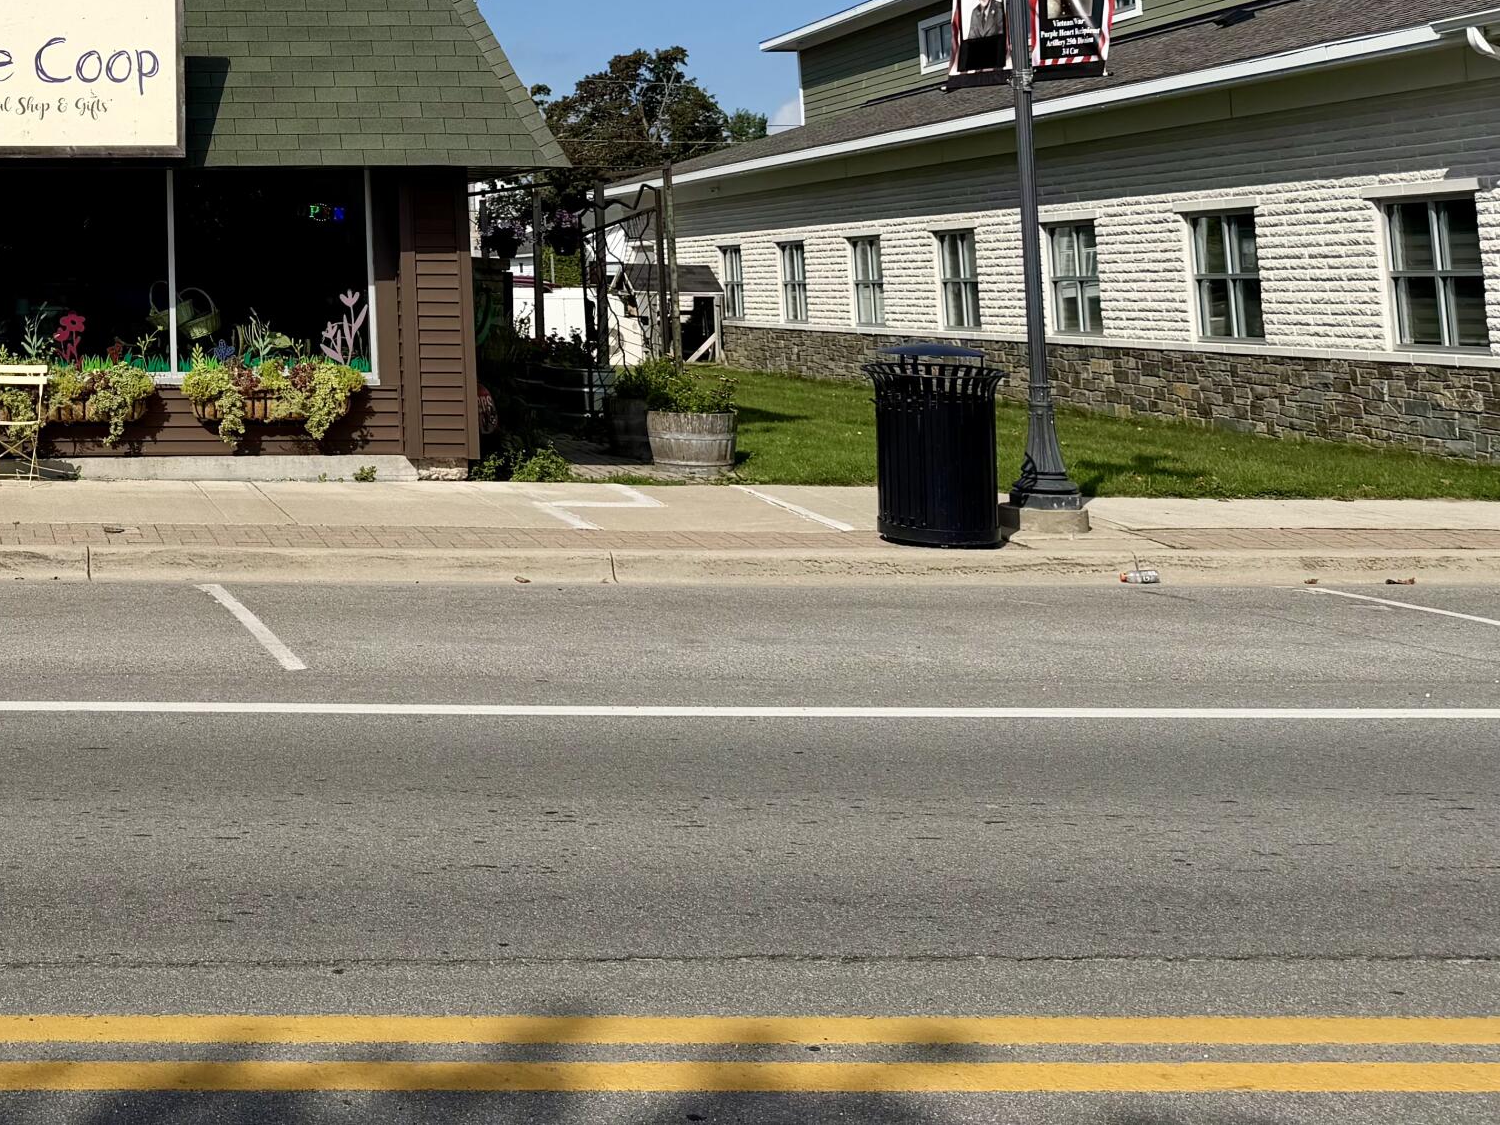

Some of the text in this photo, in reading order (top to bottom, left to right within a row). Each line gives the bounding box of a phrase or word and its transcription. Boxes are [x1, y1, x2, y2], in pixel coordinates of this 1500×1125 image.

[1040, 29, 1058, 39] Purple
[1058, 28, 1074, 37] Heart
[34, 37, 160, 95] Coop
[15, 94, 51, 121] Shop
[57, 97, 68, 114] &
